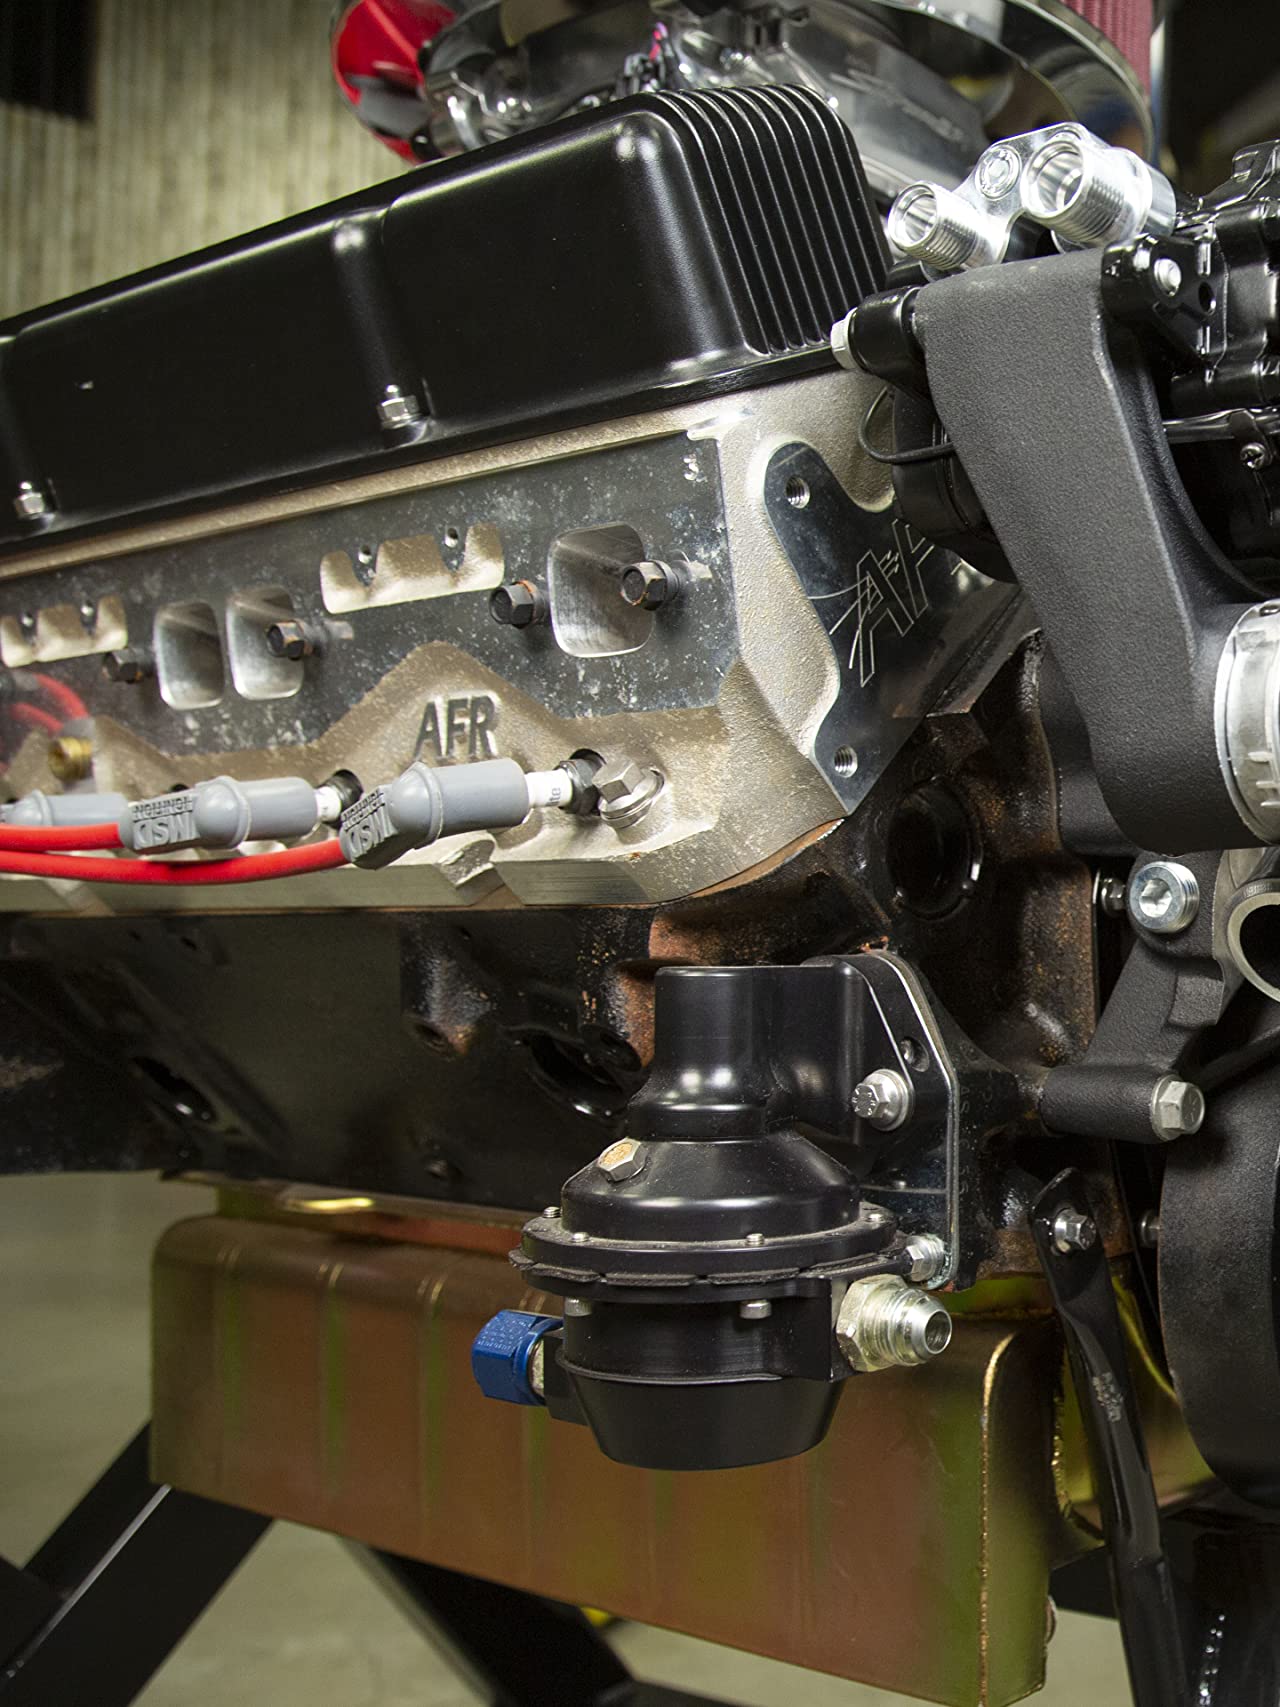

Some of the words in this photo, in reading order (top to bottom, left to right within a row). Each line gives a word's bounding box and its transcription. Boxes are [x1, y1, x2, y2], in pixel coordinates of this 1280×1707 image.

[412, 692, 499, 759] AFR
[133, 812, 200, 851] MSD
[345, 808, 399, 862] MSD
